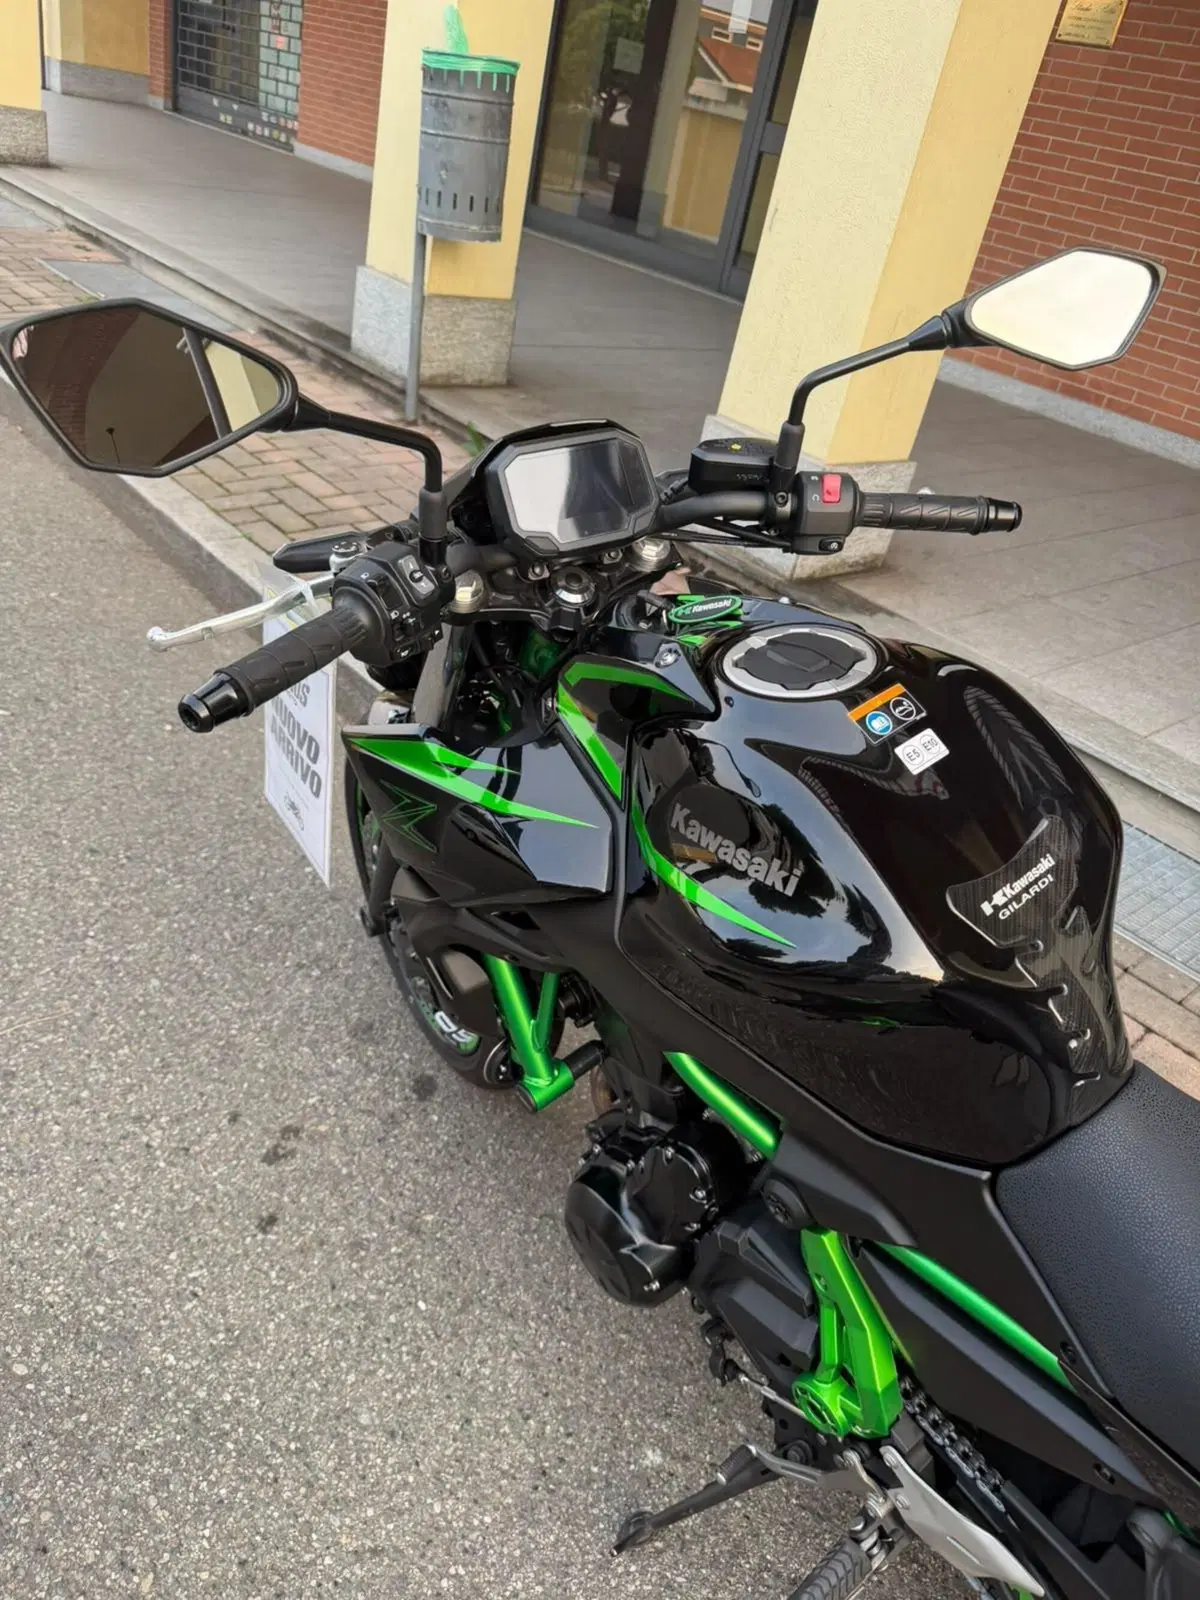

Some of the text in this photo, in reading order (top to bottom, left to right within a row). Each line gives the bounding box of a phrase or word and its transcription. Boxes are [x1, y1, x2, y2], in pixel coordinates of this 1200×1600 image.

[692, 599, 732, 613] Kawasaki
[271, 715, 322, 798] ARRIVO
[670, 803, 801, 897] Kawasaki
[998, 874, 1054, 920] GILARDI
[1003, 853, 1055, 898] Kawasaki
